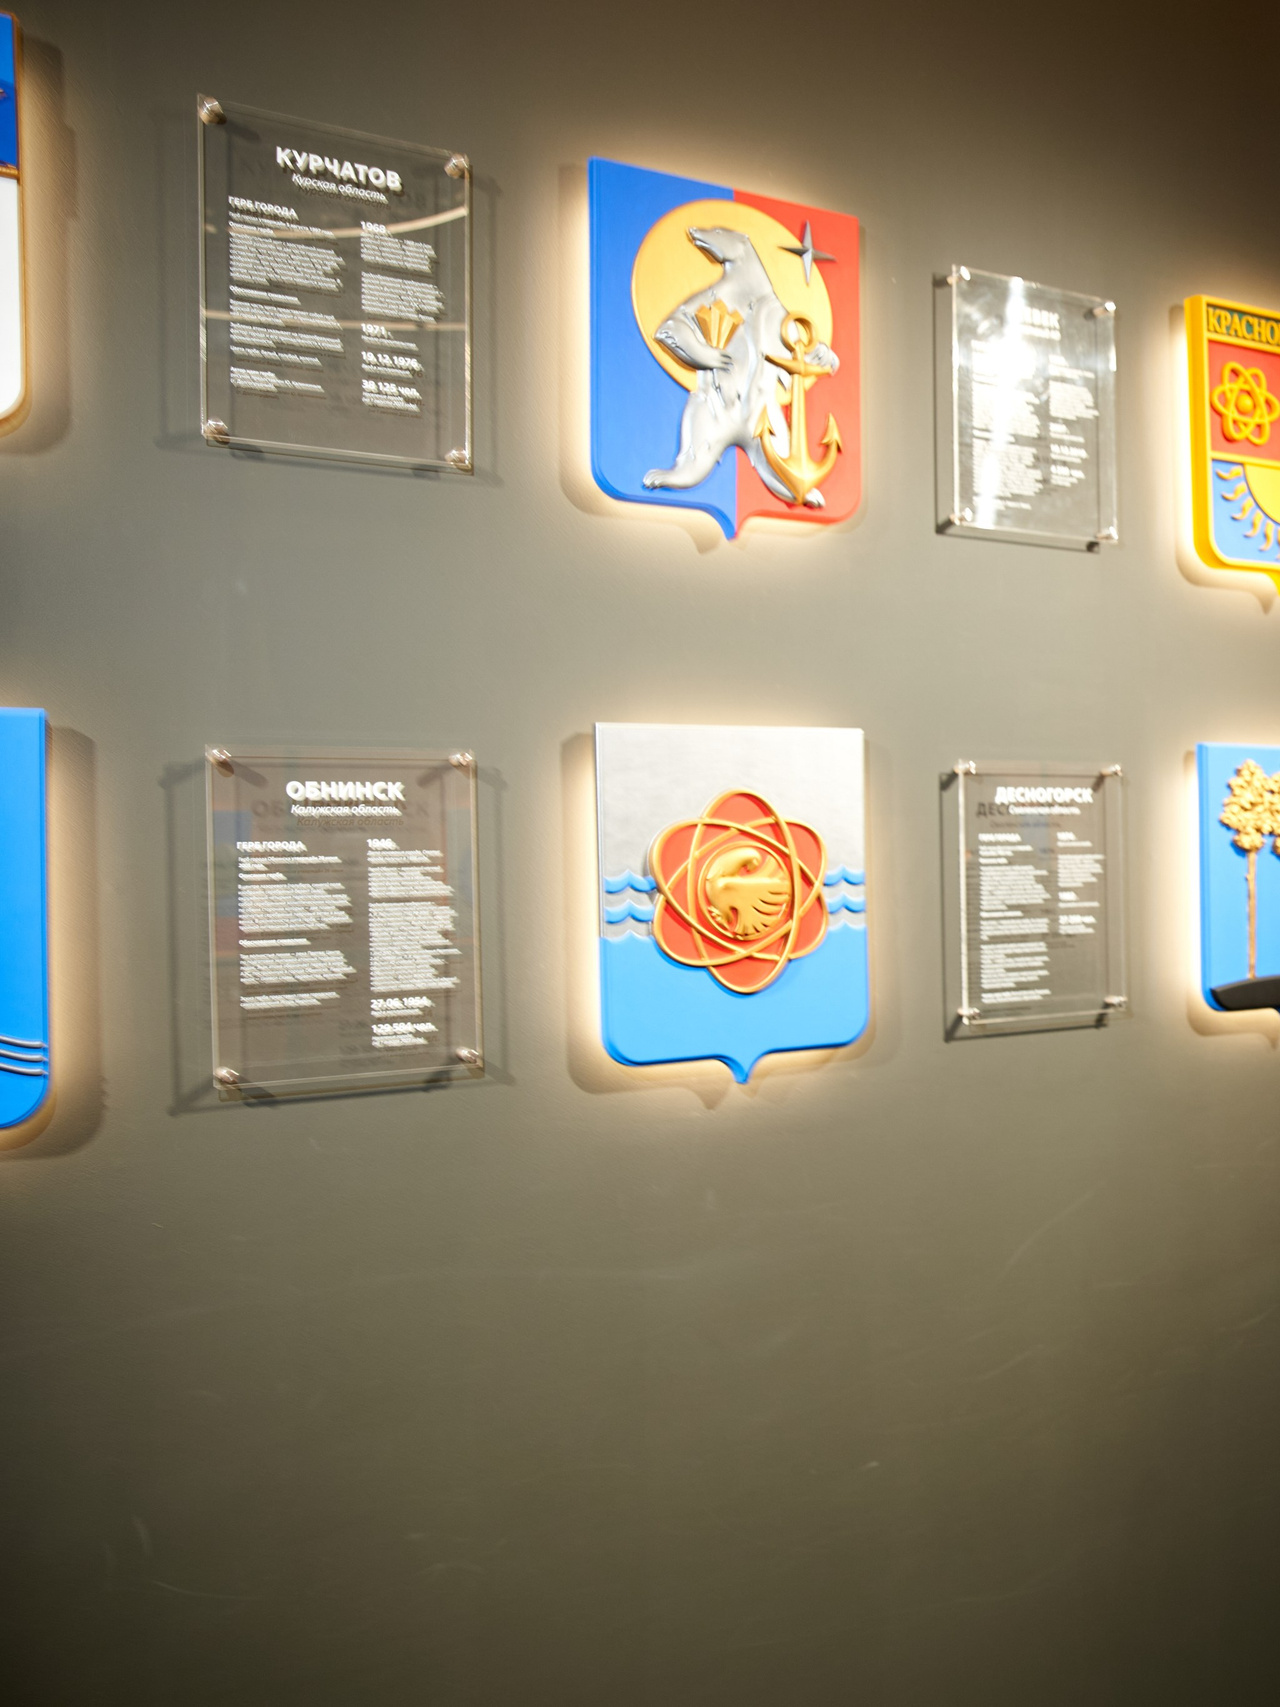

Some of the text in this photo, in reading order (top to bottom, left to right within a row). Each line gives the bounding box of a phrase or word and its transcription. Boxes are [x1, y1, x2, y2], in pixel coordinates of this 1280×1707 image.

[276, 146, 402, 192] КУРЧАТОВ
[292, 172, 388, 204] Курская область
[228, 195, 299, 220] ГЕРБ ГОРОДА
[286, 780, 406, 802] ОБНИНСК
[995, 786, 1094, 805] ДЕСНОГОРСК
[291, 803, 402, 818] Калужская область
[236, 840, 307, 853] ГЕРБ ГОРОДА
